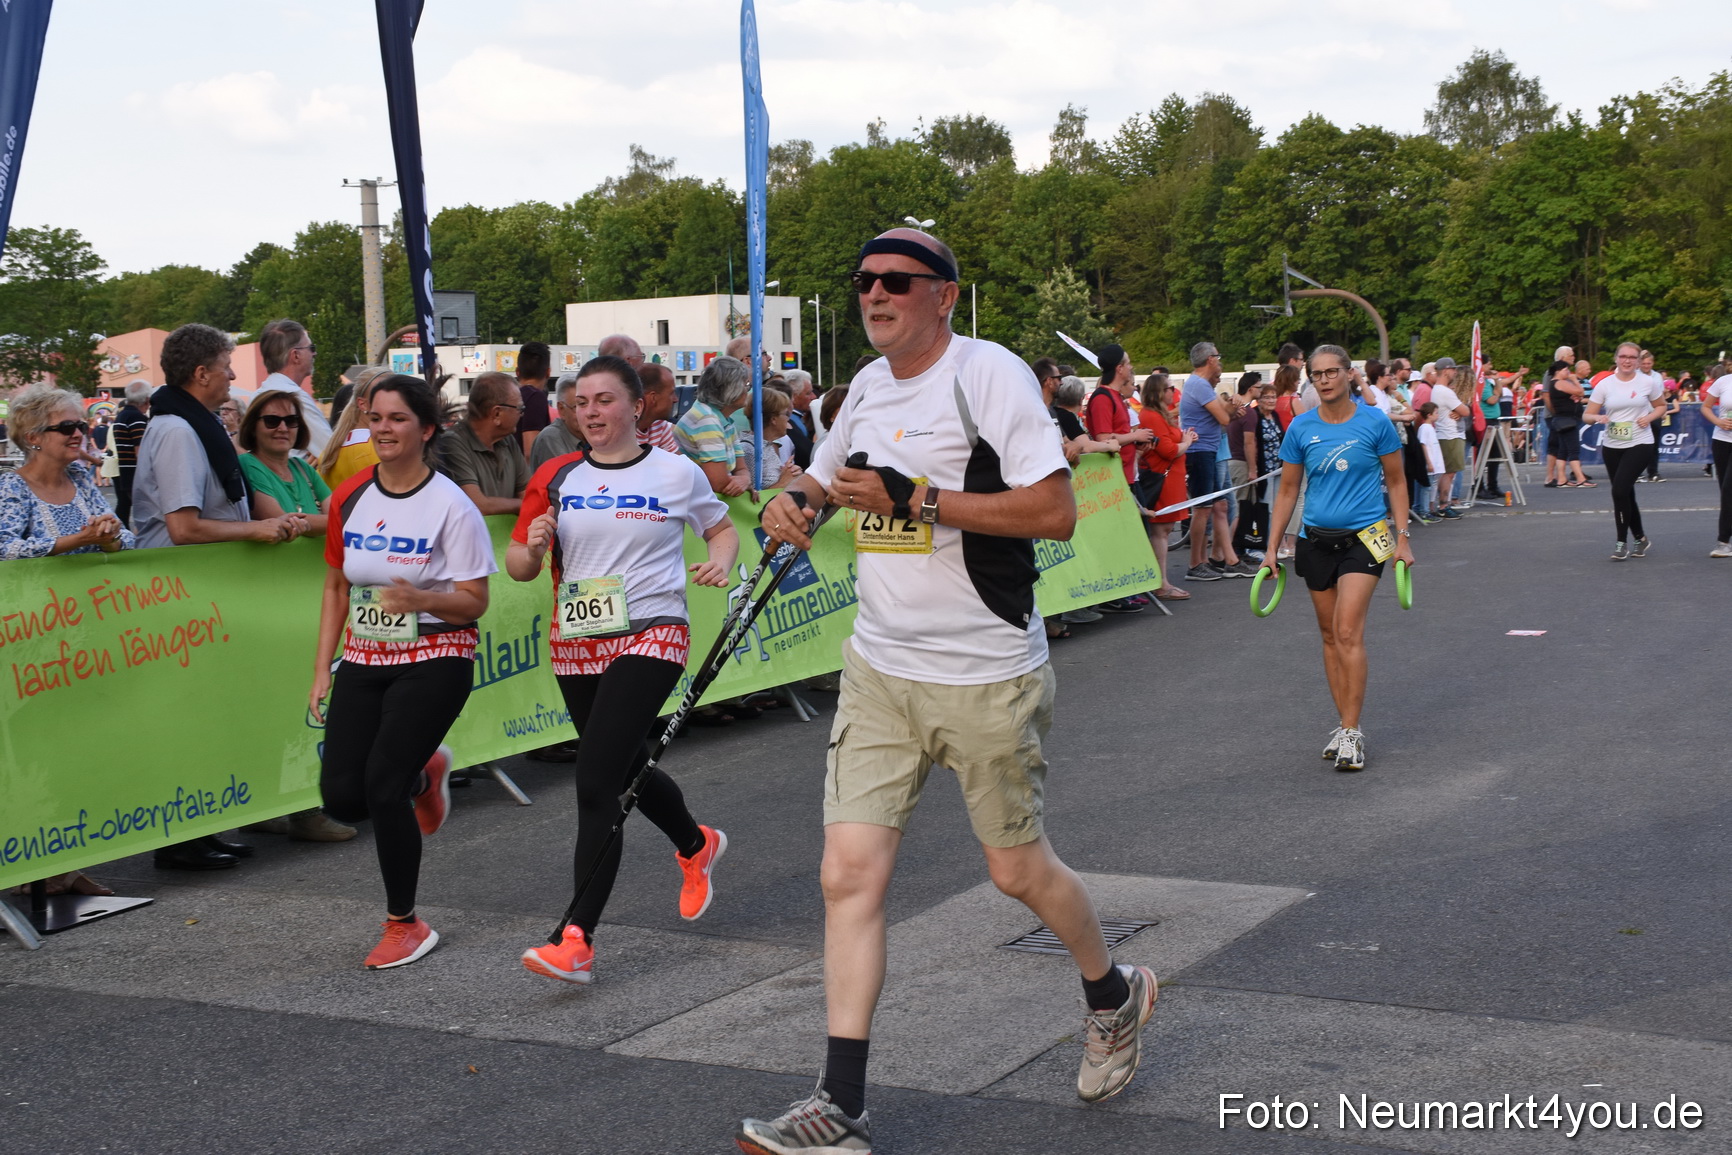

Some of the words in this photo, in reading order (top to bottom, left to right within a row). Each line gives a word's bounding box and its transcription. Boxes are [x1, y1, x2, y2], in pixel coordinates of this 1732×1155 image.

[615, 511, 668, 523] energie
[87, 575, 191, 621] Firmen
[564, 596, 614, 622] 2061
[356, 606, 407, 627] 2062
[586, 618, 614, 626] Stephanie
[774, 622, 821, 653] neumarkt
[12, 640, 116, 699] laufen
[119, 601, 230, 668] länger!
[415, 645, 460, 662] AVIA
